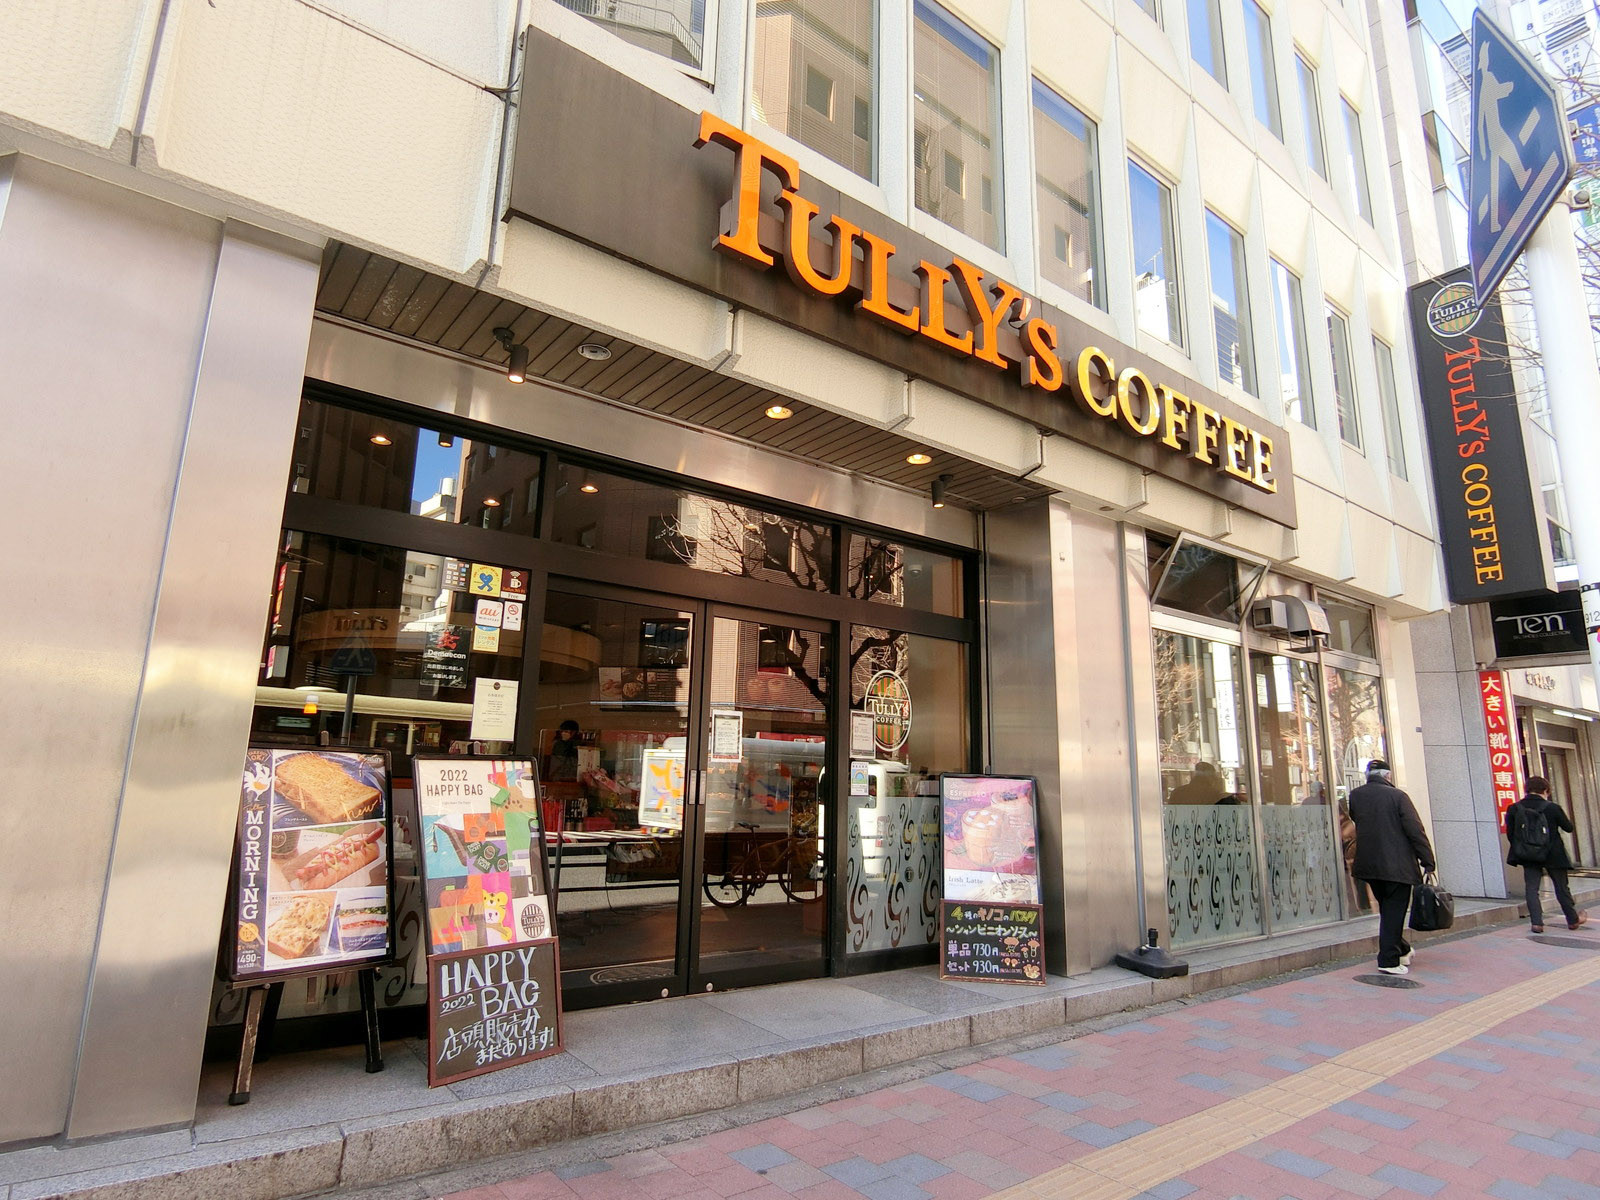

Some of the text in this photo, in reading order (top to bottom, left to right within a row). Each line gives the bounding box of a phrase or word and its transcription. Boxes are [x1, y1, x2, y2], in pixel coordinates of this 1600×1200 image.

[693, 110, 1278, 494] TULLY'S COFFEE
[1444, 337, 1505, 585] TULLY'S COFFEE
[480, 607, 500, 617] au
[426, 783, 483, 797] HAPPY BAG
[440, 769, 468, 781] 2022
[242, 811, 264, 920] MORNING
[948, 940, 971, 957] 単品
[441, 947, 537, 998] HAPPY
[440, 980, 540, 1018] 2022 BAG
[437, 1007, 541, 1065] 店頭販売分
